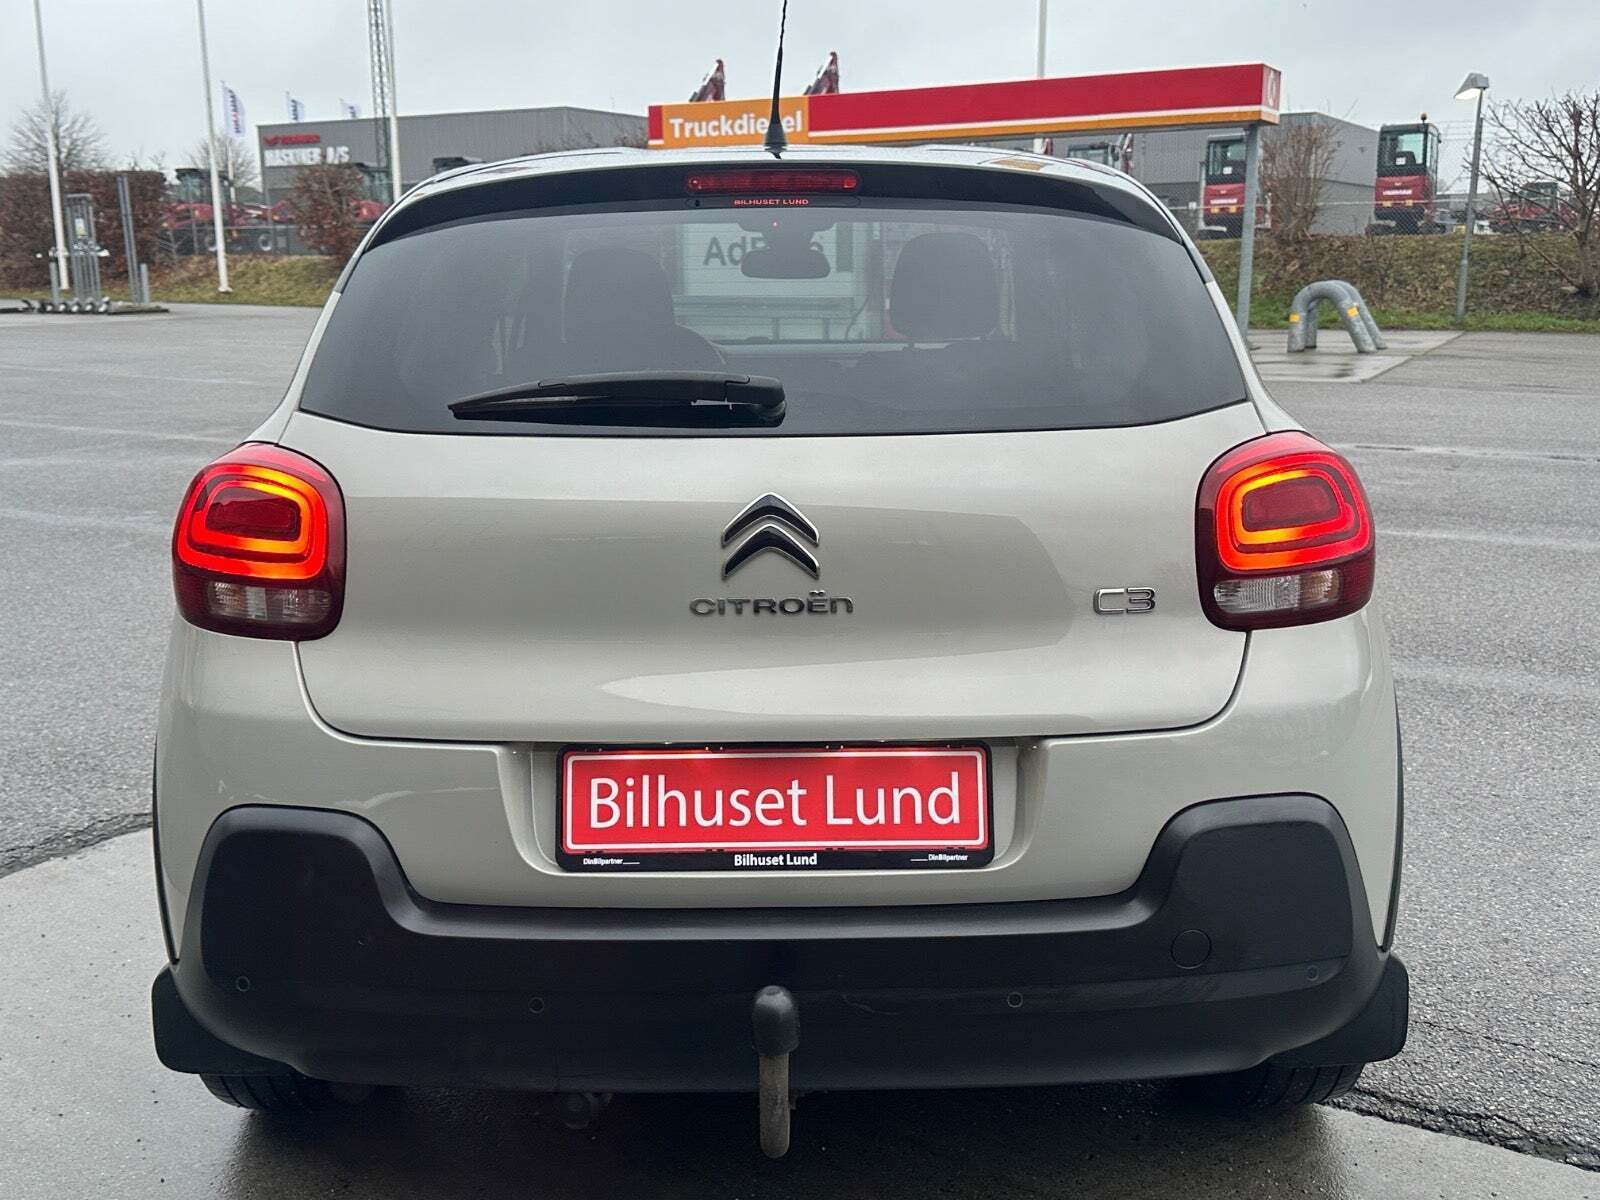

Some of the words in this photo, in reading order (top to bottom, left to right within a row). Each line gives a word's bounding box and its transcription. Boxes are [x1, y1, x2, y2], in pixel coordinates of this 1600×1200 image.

[669, 110, 802, 138] Truckdieel
[733, 198, 781, 206] BILHUSET
[782, 198, 809, 206] LUND
[1092, 586, 1156, 615] C3
[589, 774, 808, 829] Bilhuset
[825, 771, 961, 826] Lund
[733, 854, 784, 867] Bilhuset
[785, 853, 818, 866] Lund
